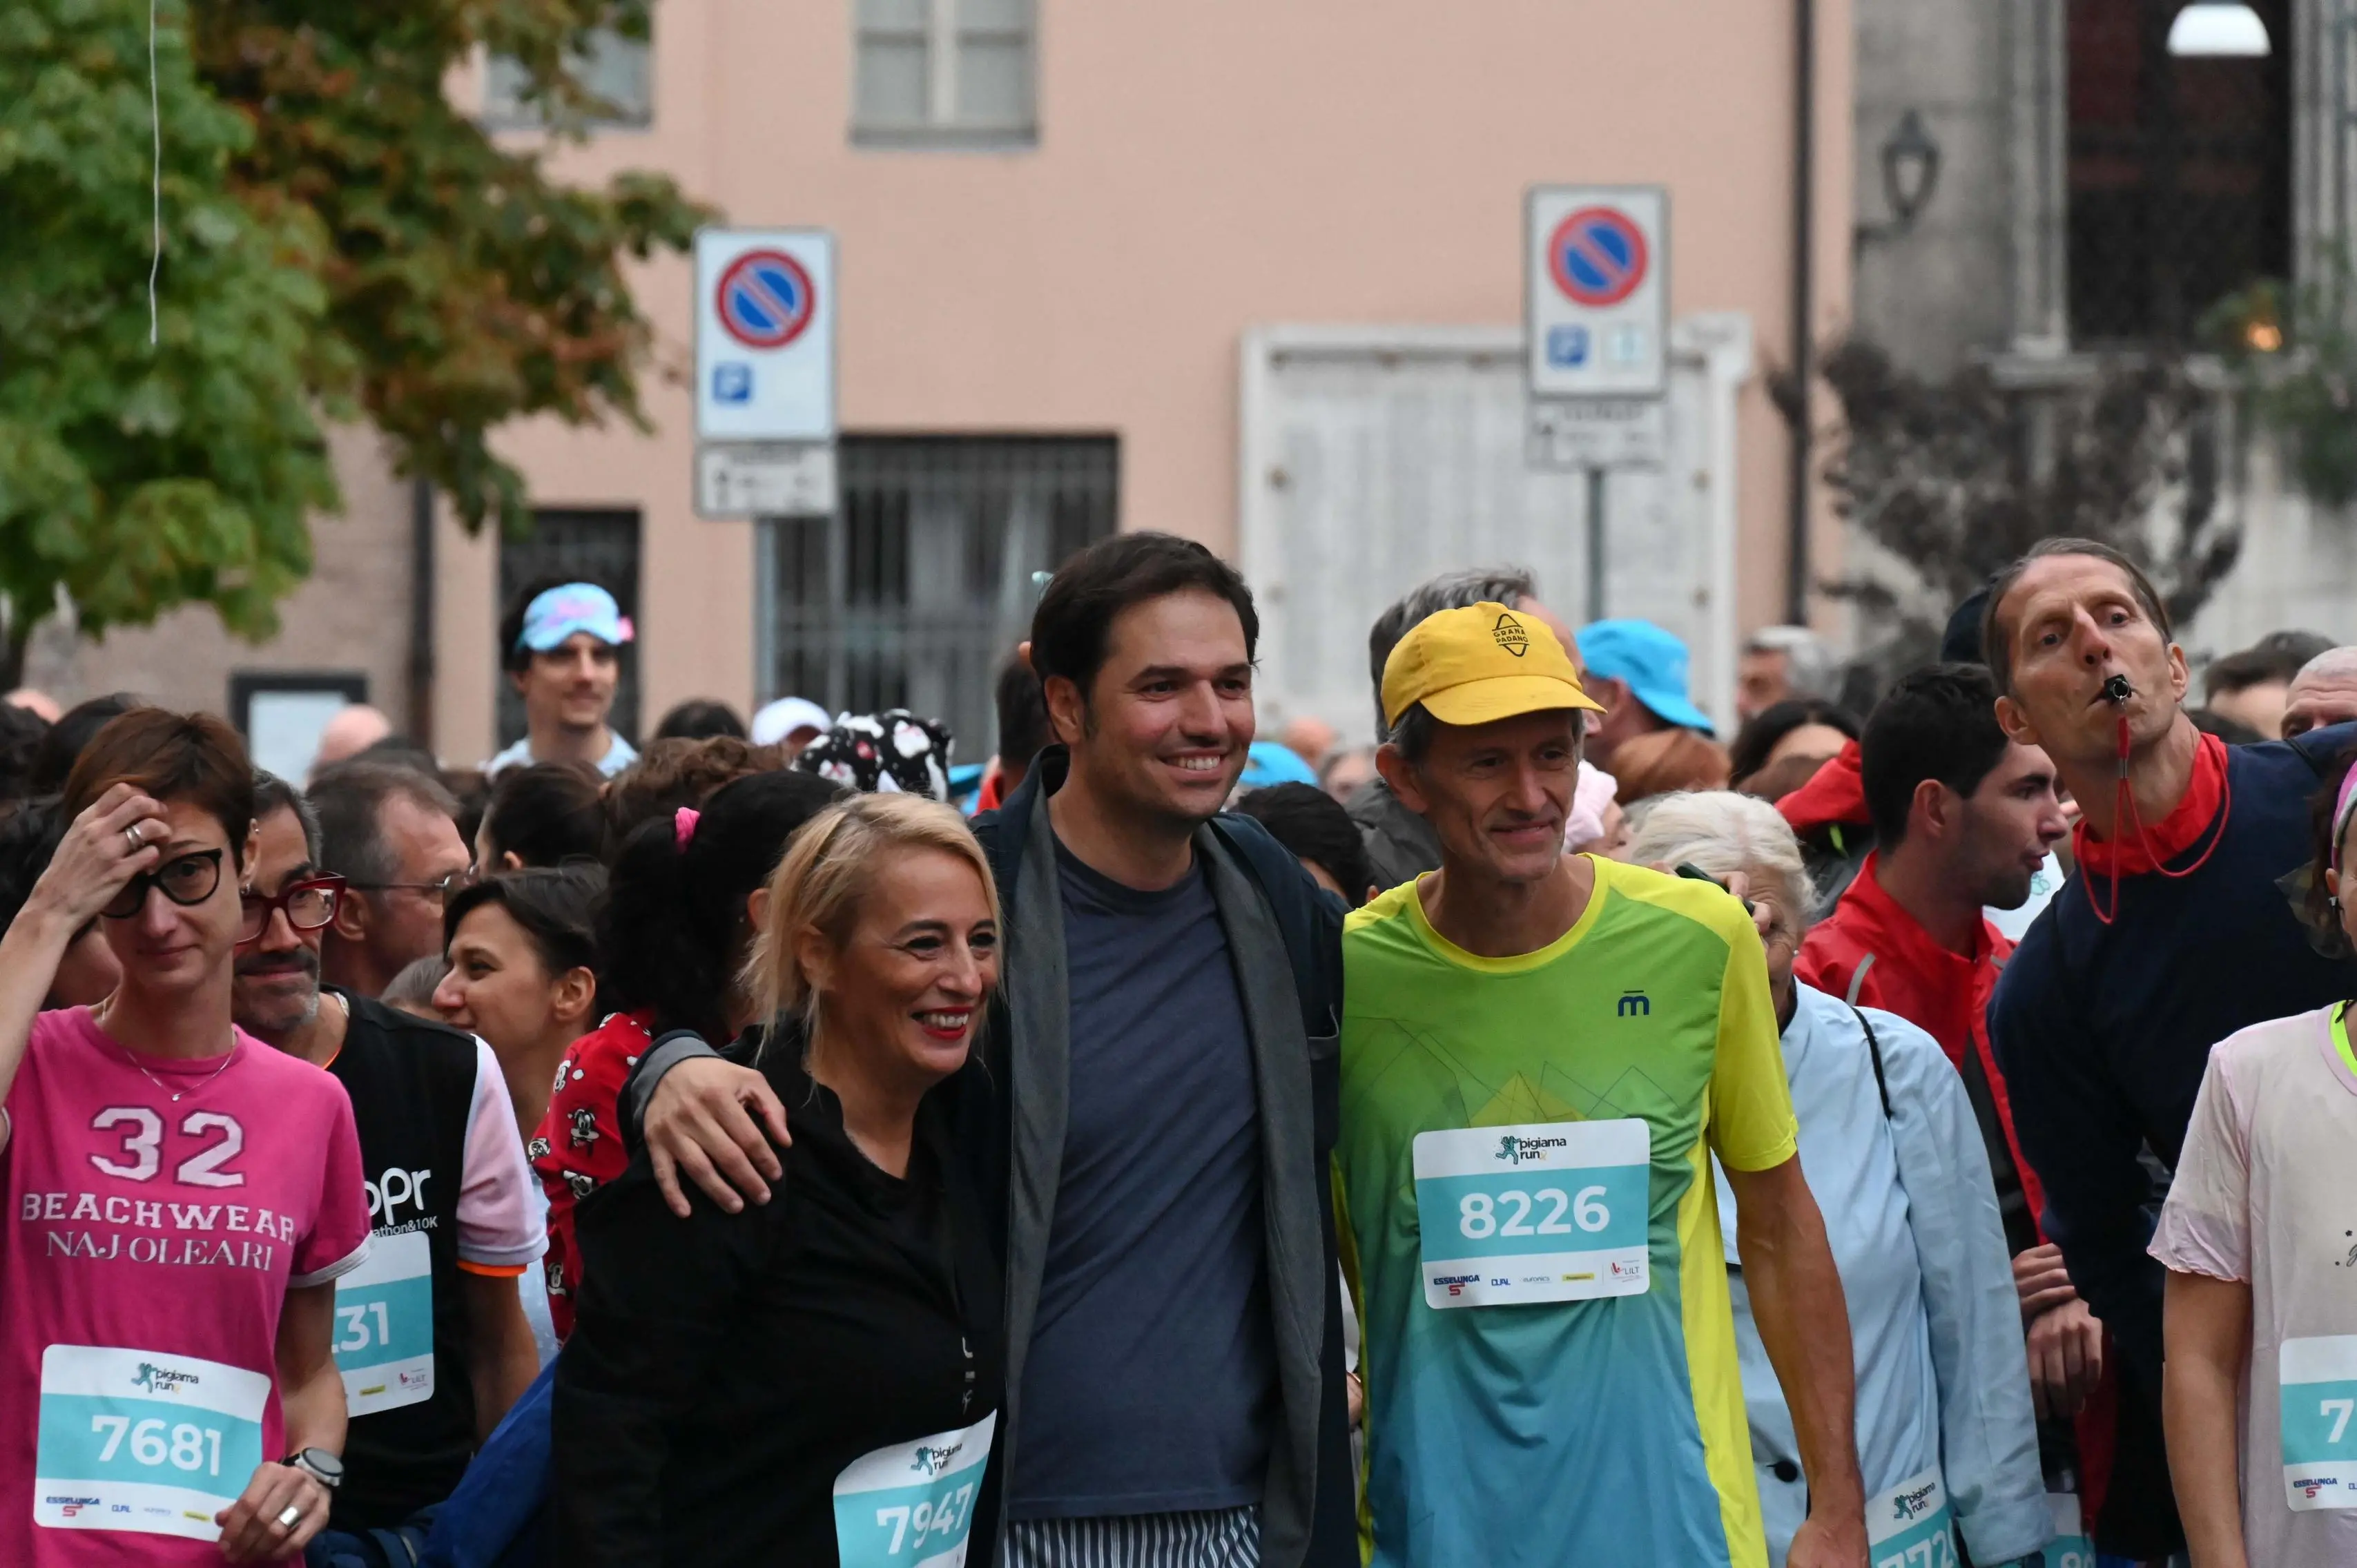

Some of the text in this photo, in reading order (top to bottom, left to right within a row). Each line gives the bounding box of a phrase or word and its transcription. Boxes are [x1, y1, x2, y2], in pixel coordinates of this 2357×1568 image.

[1493, 628, 1526, 637] GRANA
[1496, 635, 1529, 643] PADANO
[90, 1105, 245, 1188] 32
[1520, 1137, 1567, 1151] pigiama
[1520, 1150, 1540, 1160] run
[21, 1192, 295, 1245] BEACHWEAR
[1459, 1185, 1611, 1239] 8226
[1433, 1275, 1480, 1285] ESSELUNGA
[331, 1301, 390, 1354] 31
[156, 1368, 199, 1384] pigiama
[155, 1382, 174, 1391] run
[91, 1414, 222, 1476] 7681
[2293, 1478, 2338, 1489] ESSELUNGA
[46, 1496, 100, 1506] ESSELUNGA
[1911, 1500, 1927, 1513] run
[876, 1481, 973, 1556] 7947
